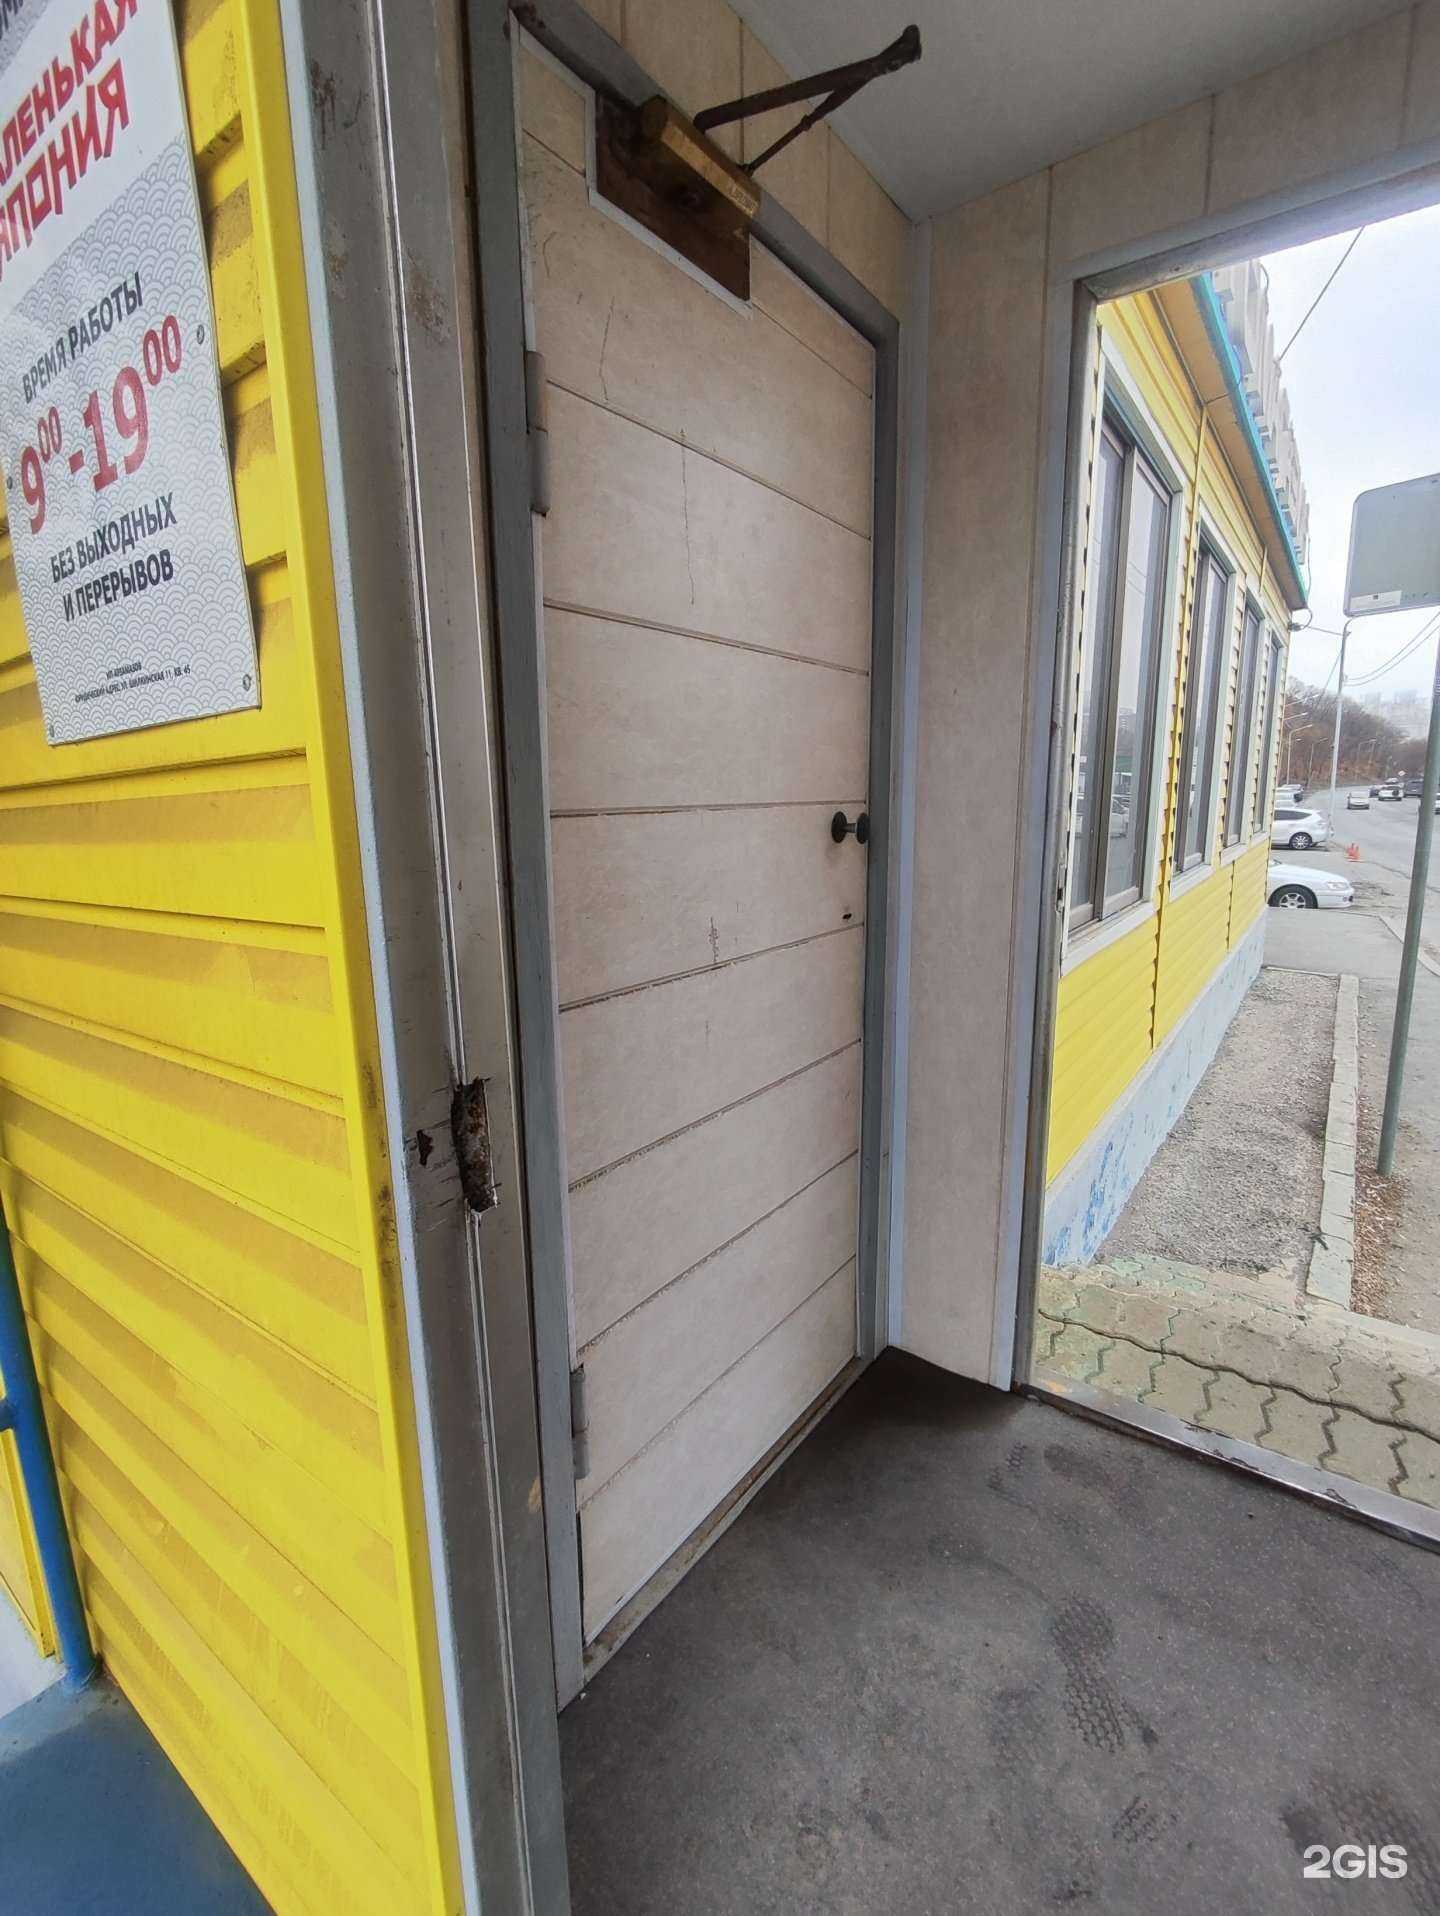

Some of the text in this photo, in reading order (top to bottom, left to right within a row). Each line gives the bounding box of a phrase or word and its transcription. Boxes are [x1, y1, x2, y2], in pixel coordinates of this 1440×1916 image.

[0, 0, 138, 187] ЛЕНЬКА
[22, 272, 143, 404] ВРЕМЯ РАБОТЫ
[50, 492, 177, 583] БЕЗ ВЫХОДНЫХ
[62, 549, 174, 622] И ПЕРЕРЫВОВ
